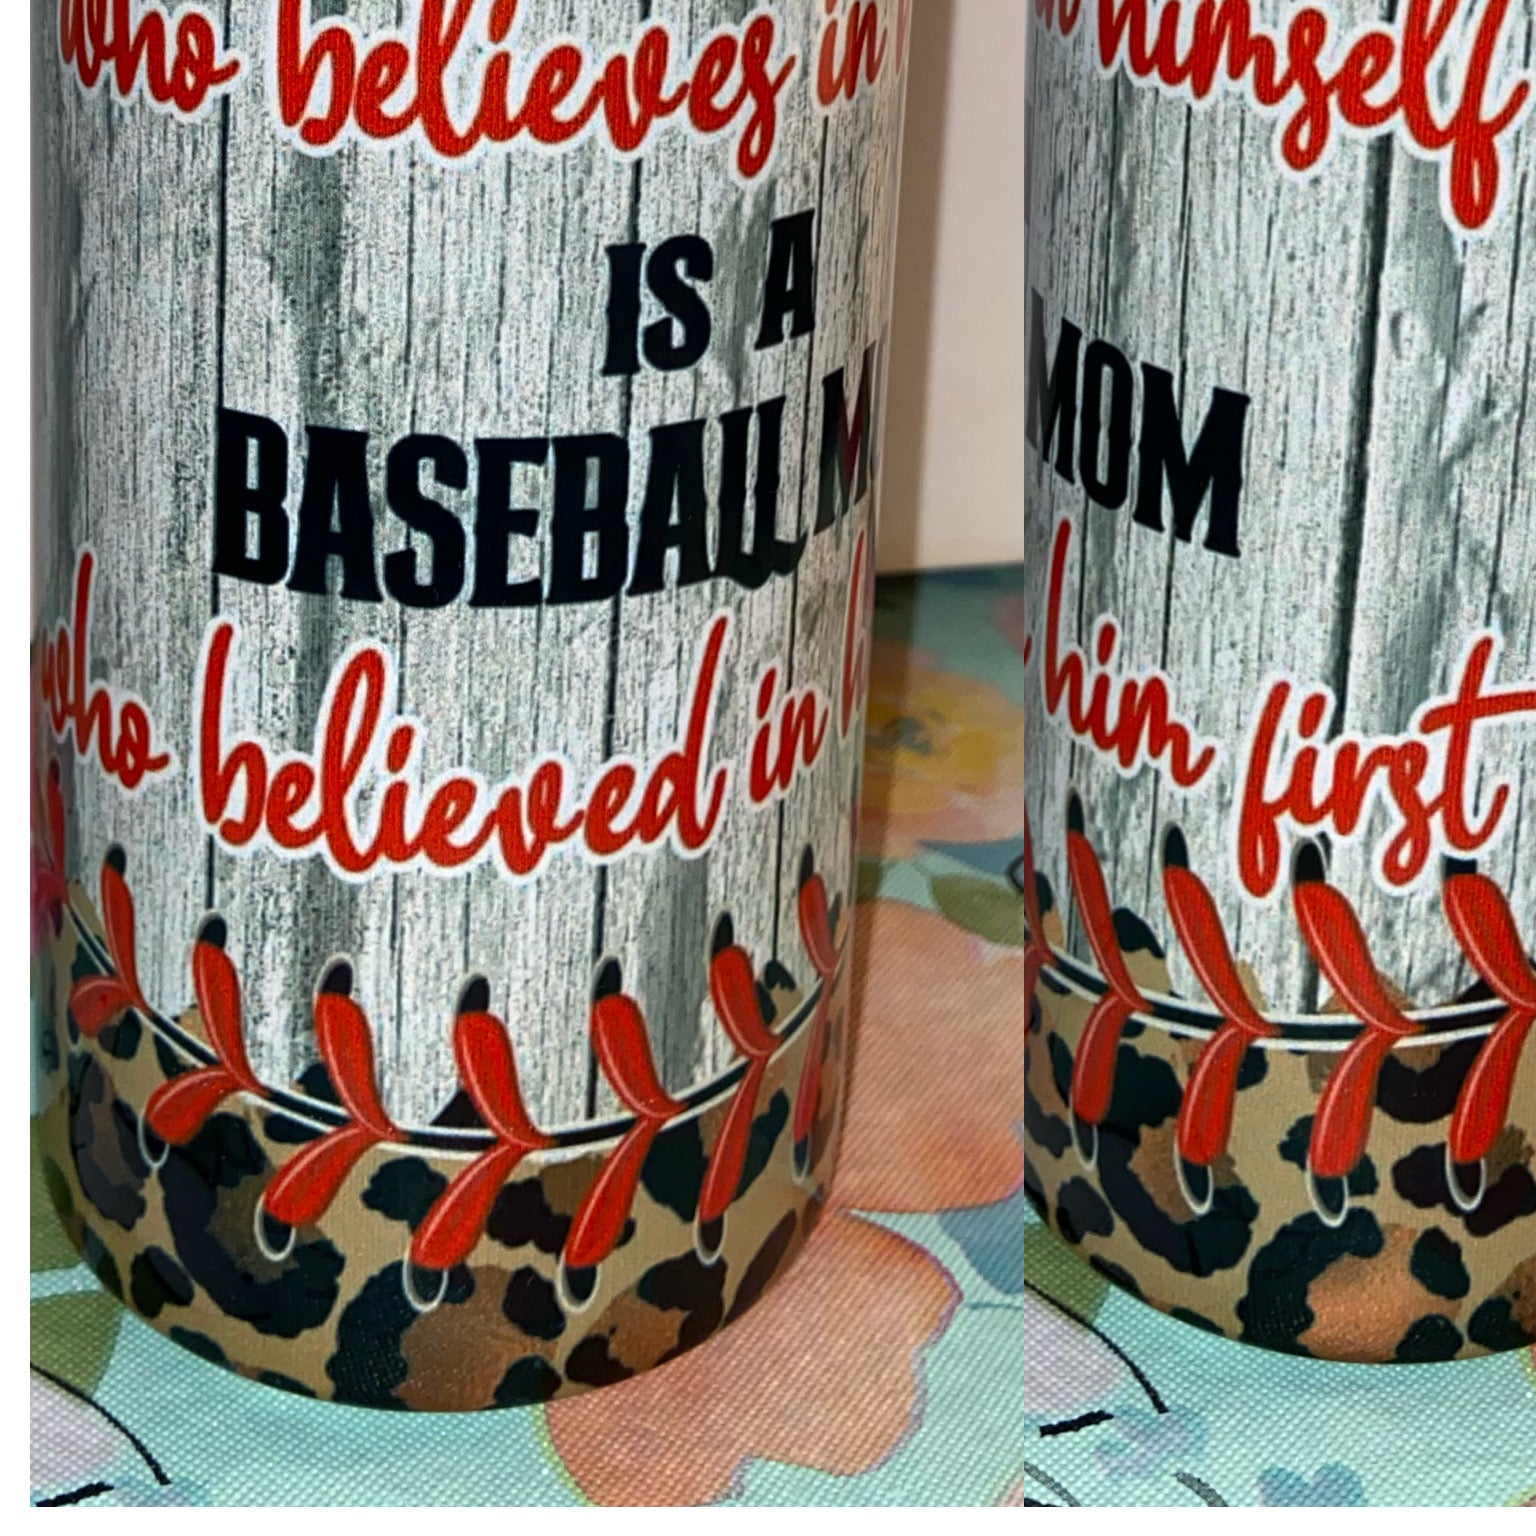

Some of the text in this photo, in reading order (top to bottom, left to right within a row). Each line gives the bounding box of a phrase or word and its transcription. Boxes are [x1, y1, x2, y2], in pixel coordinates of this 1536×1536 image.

[602, 208, 816, 377] IS A
[1025, 286, 1250, 558] MOM
[213, 396, 812, 609] BASEBALL
[41, 550, 170, 790] who
[199, 616, 728, 874] believed
[749, 668, 829, 804] in
[1045, 517, 1215, 788] him
